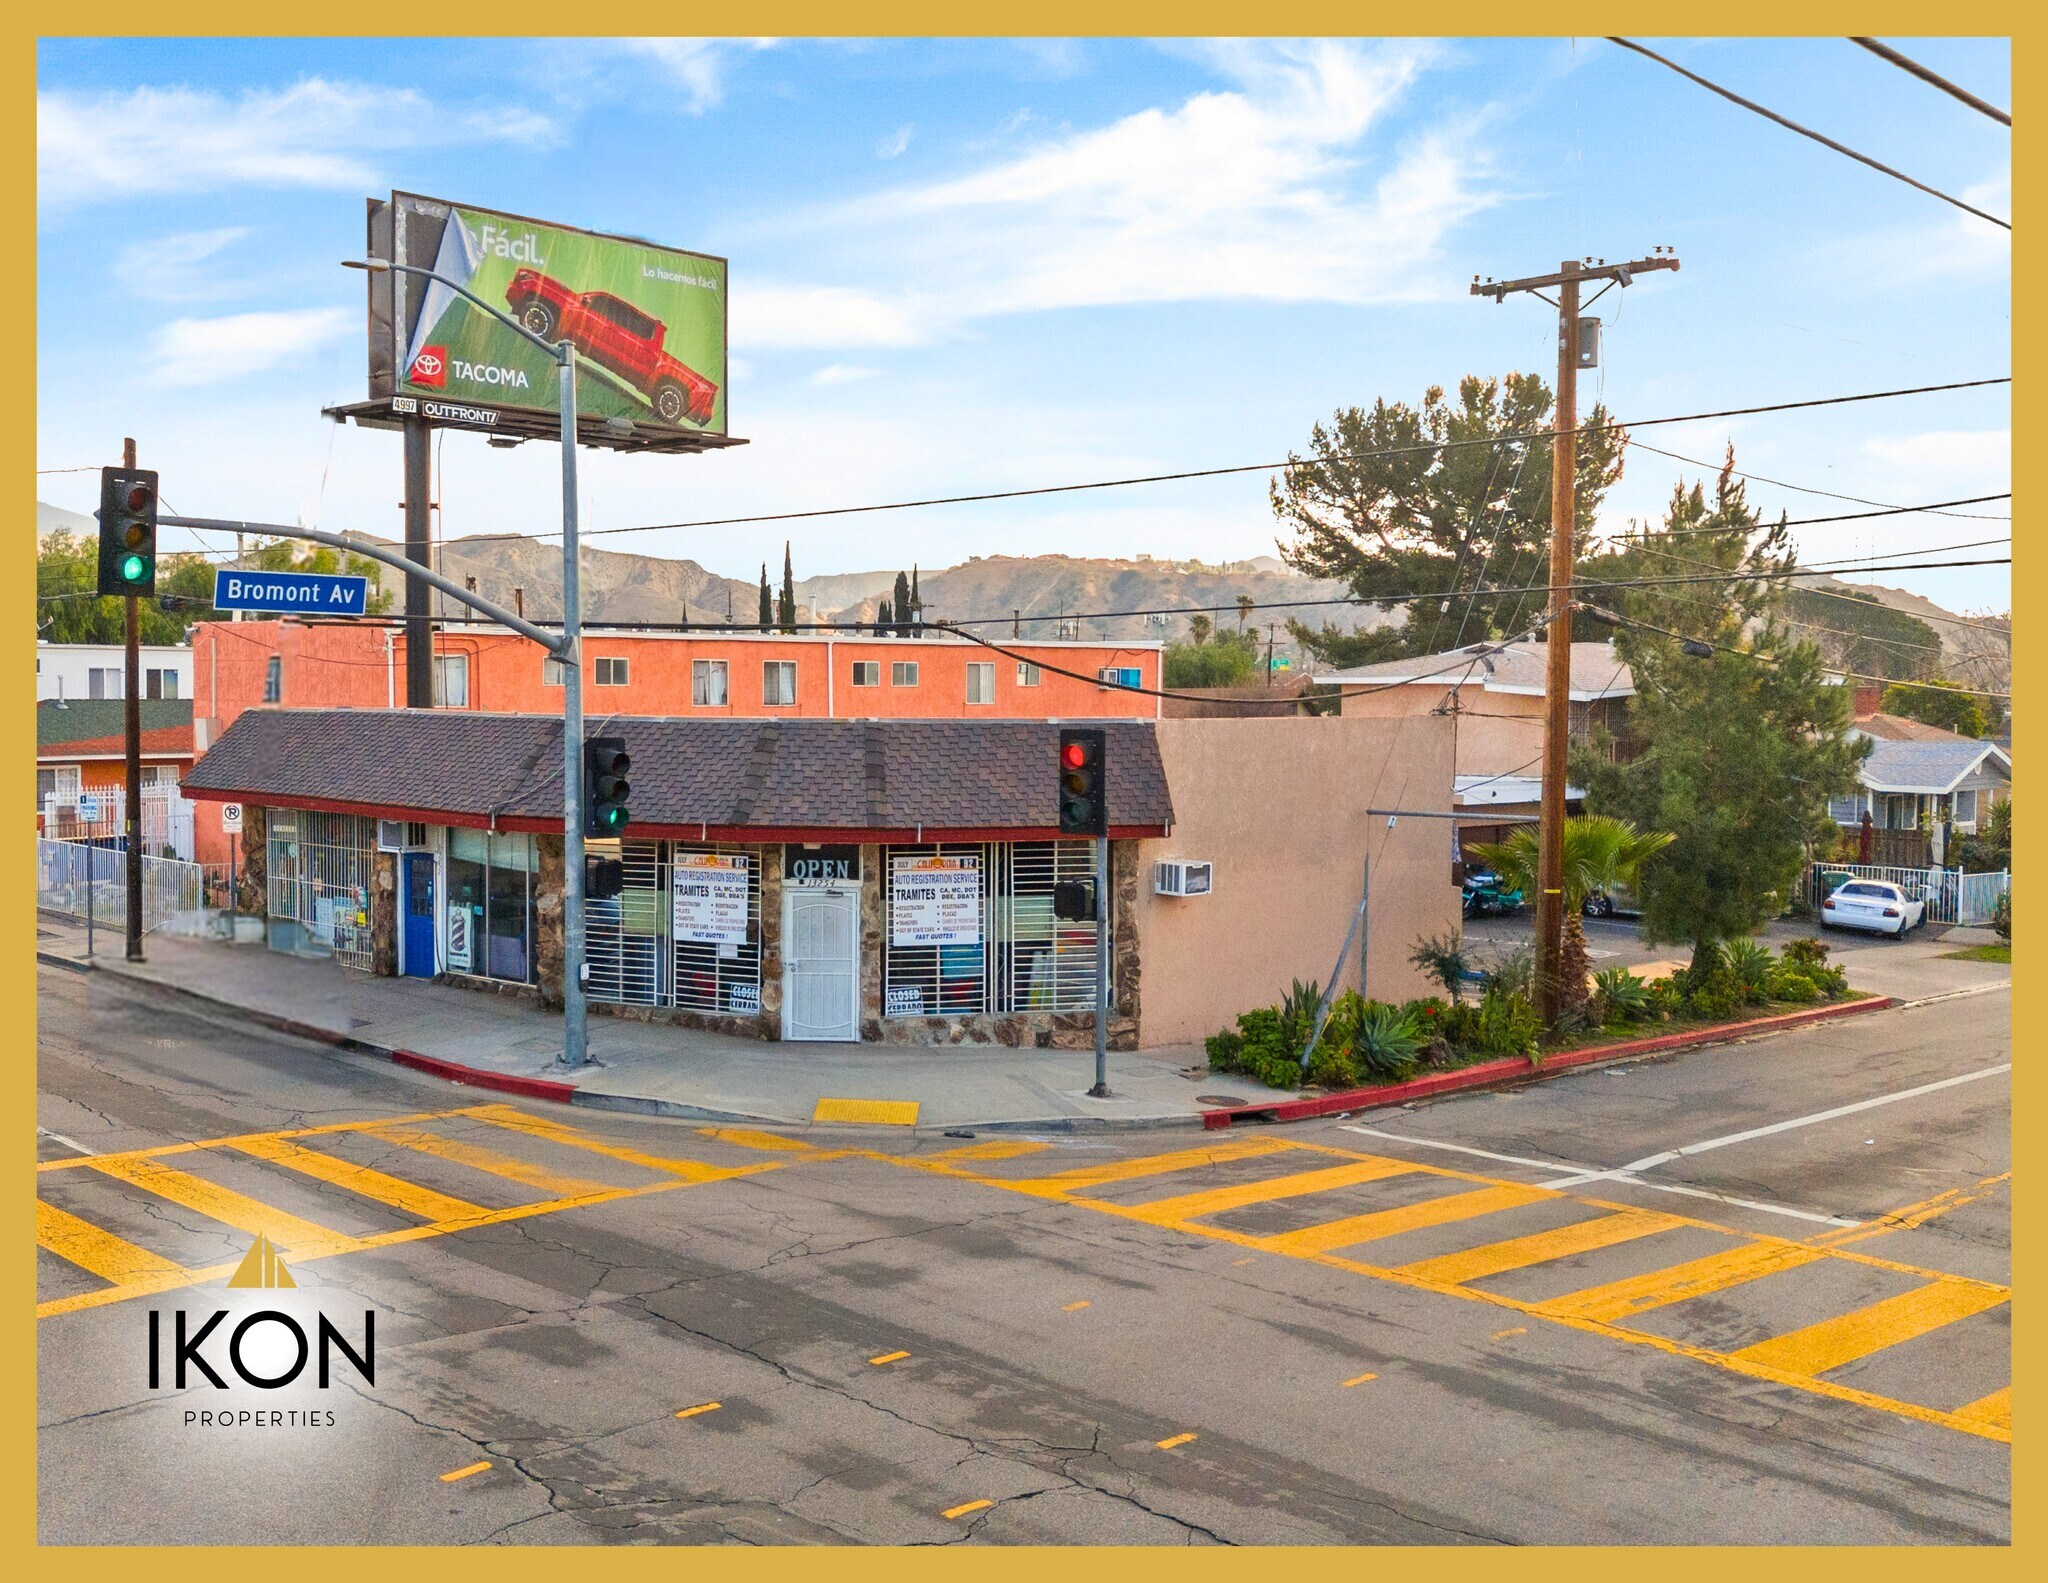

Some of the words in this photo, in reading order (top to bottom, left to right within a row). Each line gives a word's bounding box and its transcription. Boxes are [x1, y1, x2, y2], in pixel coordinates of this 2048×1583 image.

[482, 226, 544, 264] Fácil.
[644, 266, 655, 277] Lo
[658, 268, 696, 285] hacemos
[453, 360, 528, 388] TACOMA
[394, 399, 415, 410] 4997
[228, 579, 320, 602] Bromont
[329, 584, 354, 604] Av
[793, 860, 849, 878] OPEN
[675, 870, 688, 880] AUTO
[689, 871, 724, 881] REGISTRATION
[726, 872, 747, 883] SERVICE
[895, 874, 910, 884] AUTO
[911, 874, 952, 884] REGISTRATION
[953, 873, 977, 883] SERVICE
[675, 884, 709, 897] TRAMITES
[896, 888, 936, 900] TRAMITES
[733, 986, 758, 999] CLOSE
[889, 990, 920, 1001] CLOSED
